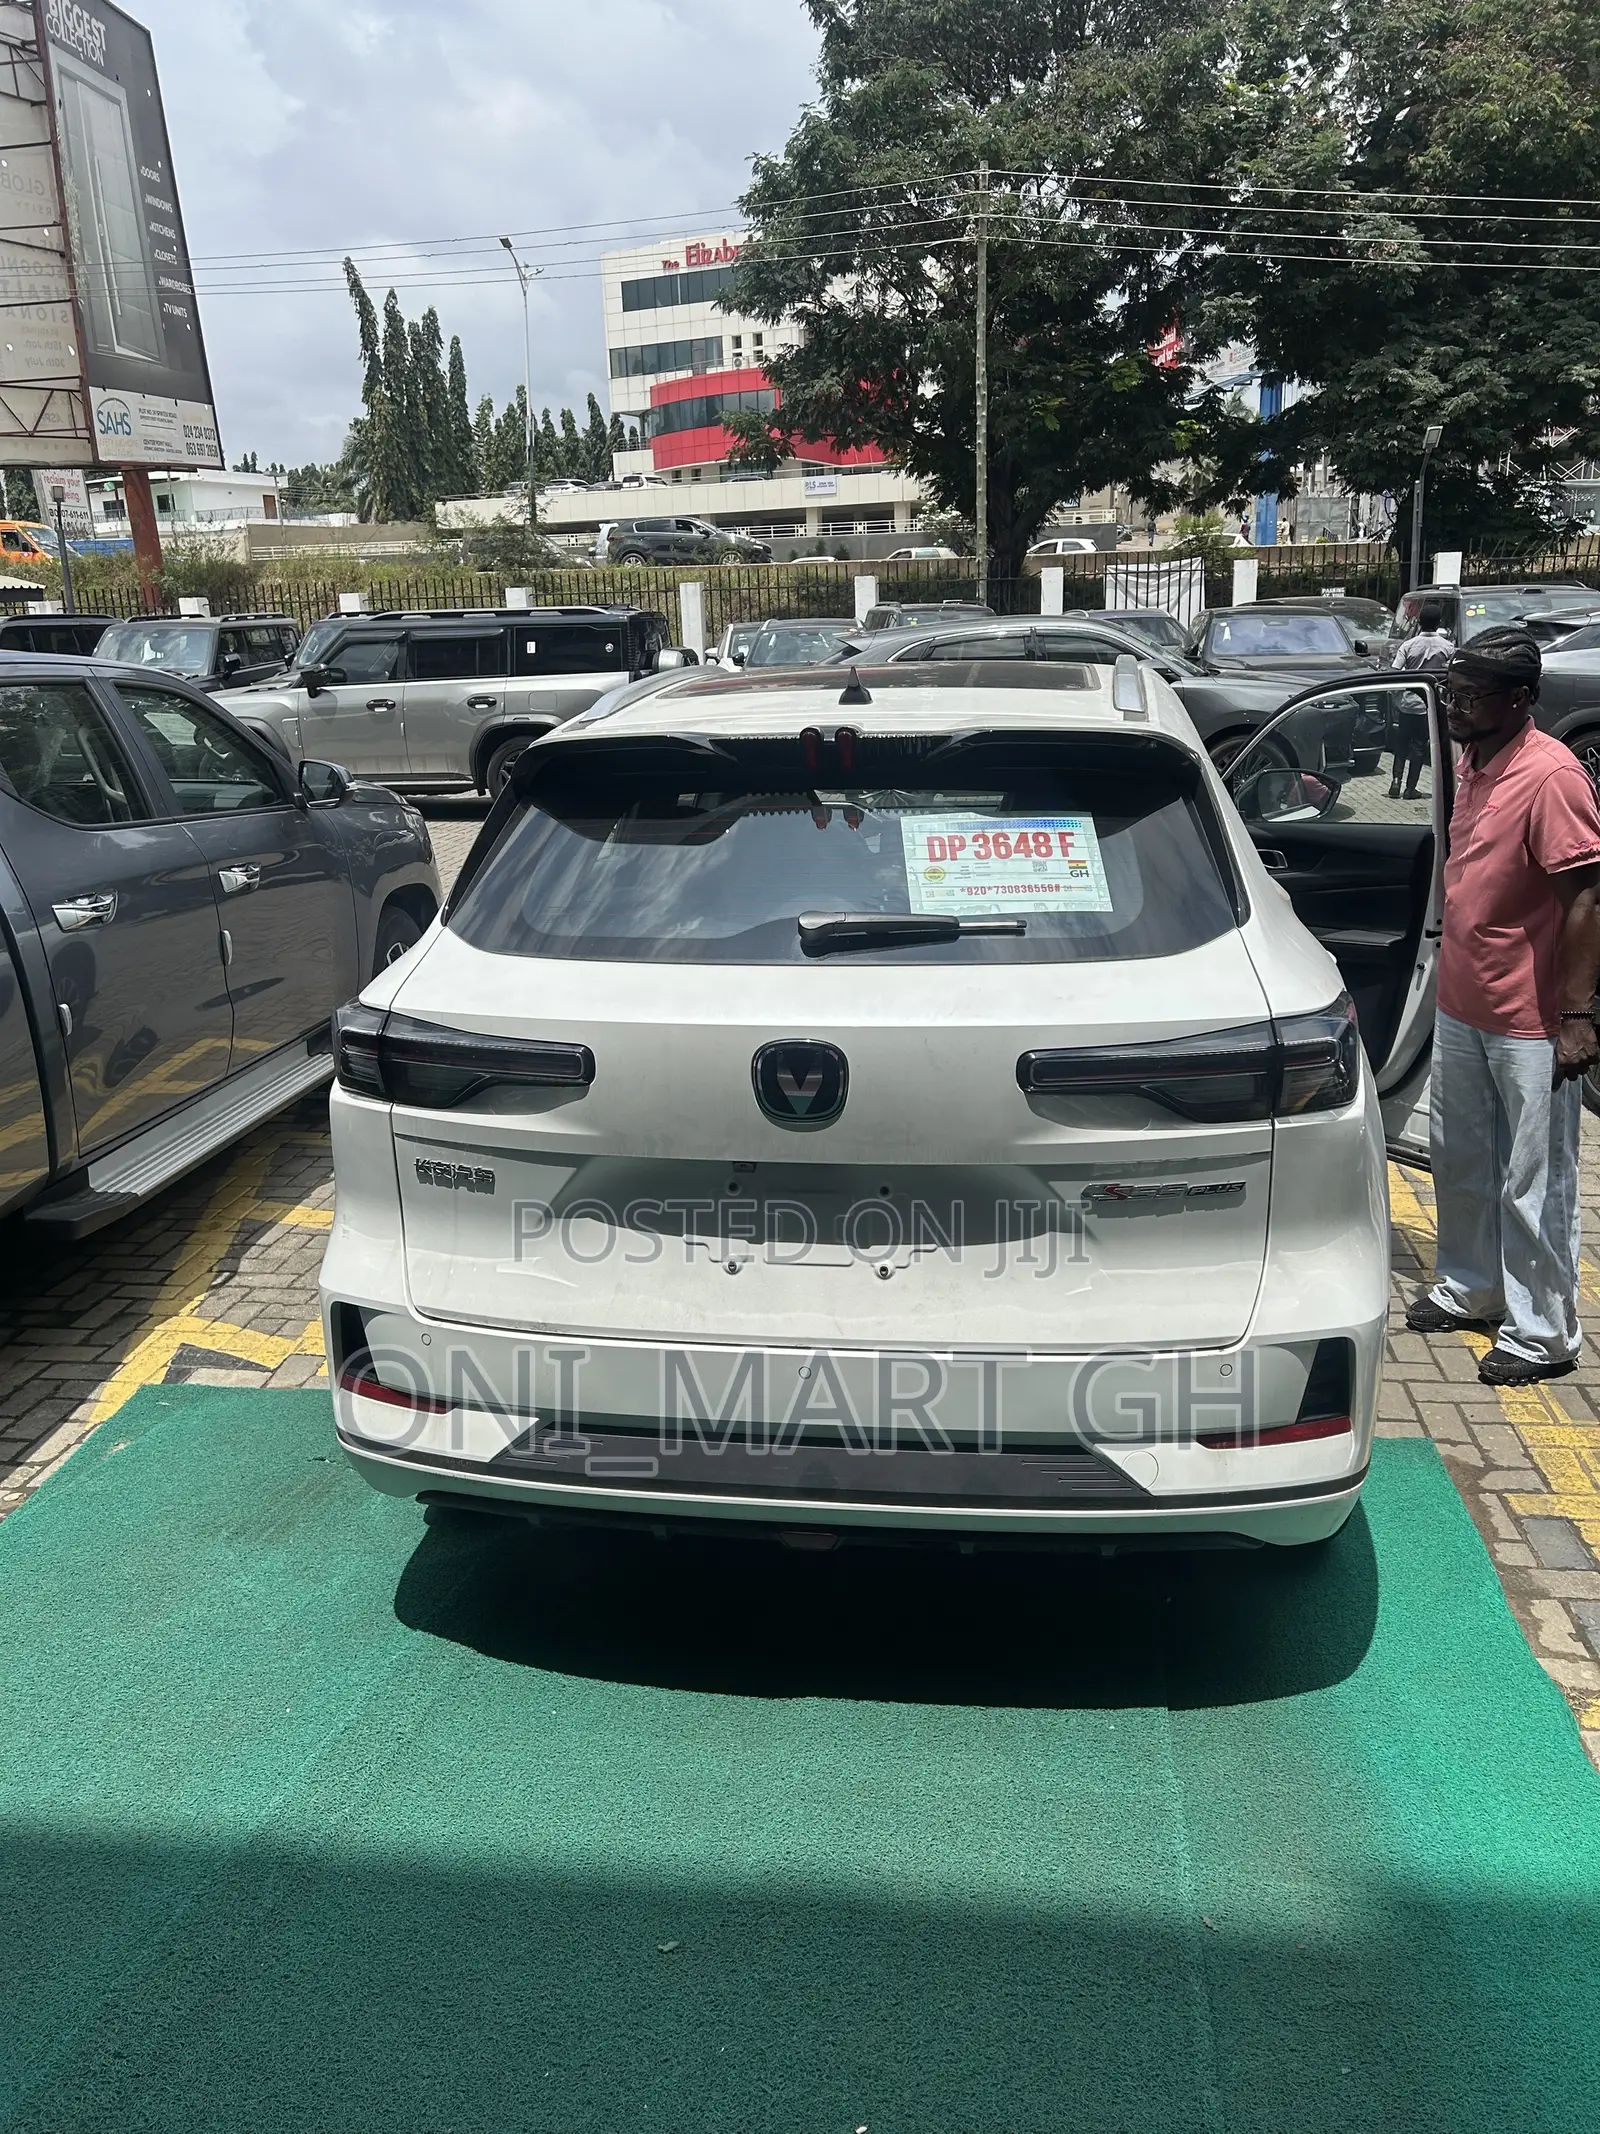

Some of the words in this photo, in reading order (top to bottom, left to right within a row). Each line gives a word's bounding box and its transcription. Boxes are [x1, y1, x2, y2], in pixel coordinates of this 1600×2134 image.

[49, 0, 106, 51] BIGGEST
[46, 12, 104, 66] COLLECTION
[142, 166, 160, 182] DOORS
[146, 193, 172, 213] WINDOWS
[150, 221, 176, 239] KITCHENS
[155, 249, 177, 265] CLOSETS
[662, 260, 679, 268] The
[160, 276, 192, 294] WARDROBES
[165, 303, 173, 314] TV
[173, 306, 187, 318] UNITS
[97, 410, 131, 435] SAHS
[43, 475, 66, 485] reclaim
[68, 478, 81, 488] your
[926, 835, 966, 862] DP
[972, 832, 1053, 860] 3648
[1058, 831, 1074, 857] F
[1070, 869, 1089, 877] GH
[1187, 1181, 1246, 1196] PLUS
